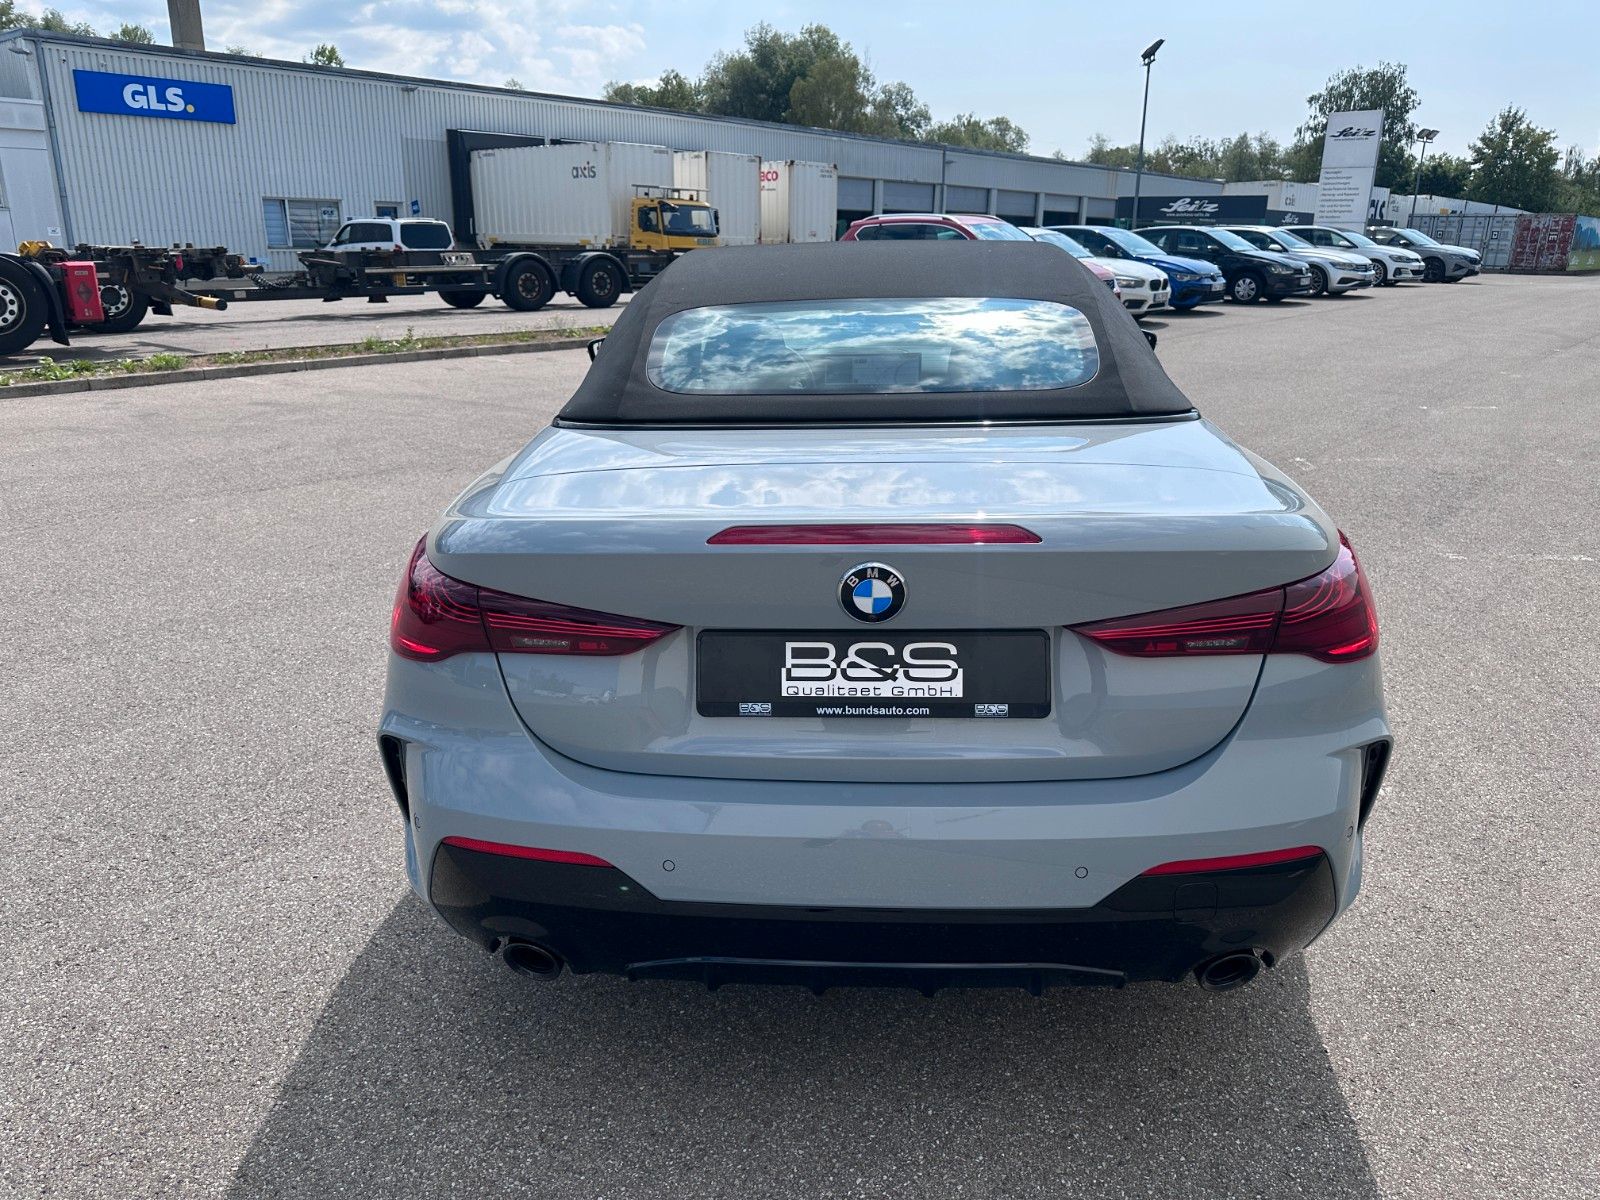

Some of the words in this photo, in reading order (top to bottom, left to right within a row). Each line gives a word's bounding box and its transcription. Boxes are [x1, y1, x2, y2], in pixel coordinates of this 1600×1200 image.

[572, 161, 597, 179] axis
[846, 567, 900, 588] BMW
[785, 641, 959, 682] B&S
[786, 684, 882, 697] Qualitaet
[740, 703, 771, 713] B&S
[816, 705, 930, 715] www.bundsauto.com
[976, 704, 1007, 714] B&S
